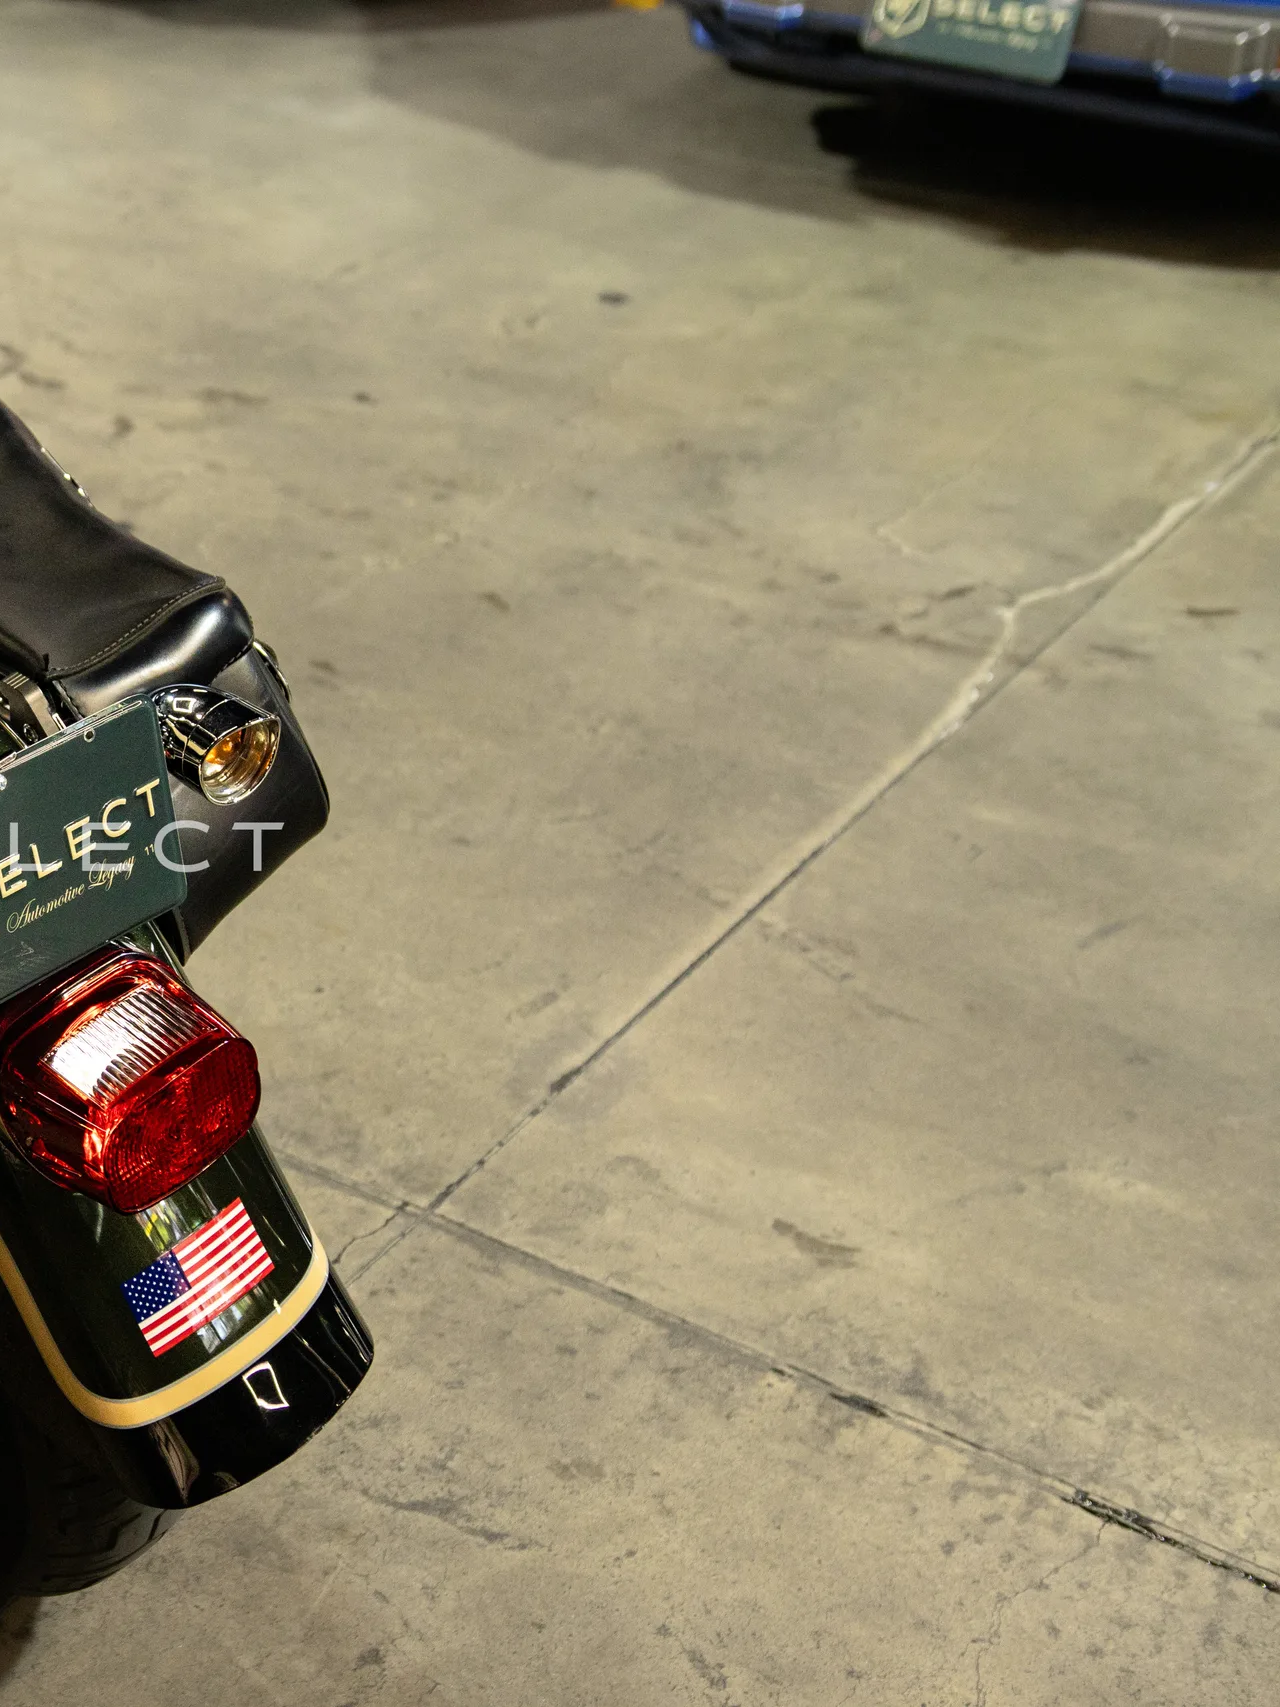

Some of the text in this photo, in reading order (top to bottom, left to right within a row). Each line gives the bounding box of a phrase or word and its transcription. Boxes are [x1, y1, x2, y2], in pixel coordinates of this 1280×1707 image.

[6, 884, 85, 933] Automotive
[88, 855, 136, 891] Legacy
[144, 843, 155, 856] 11
